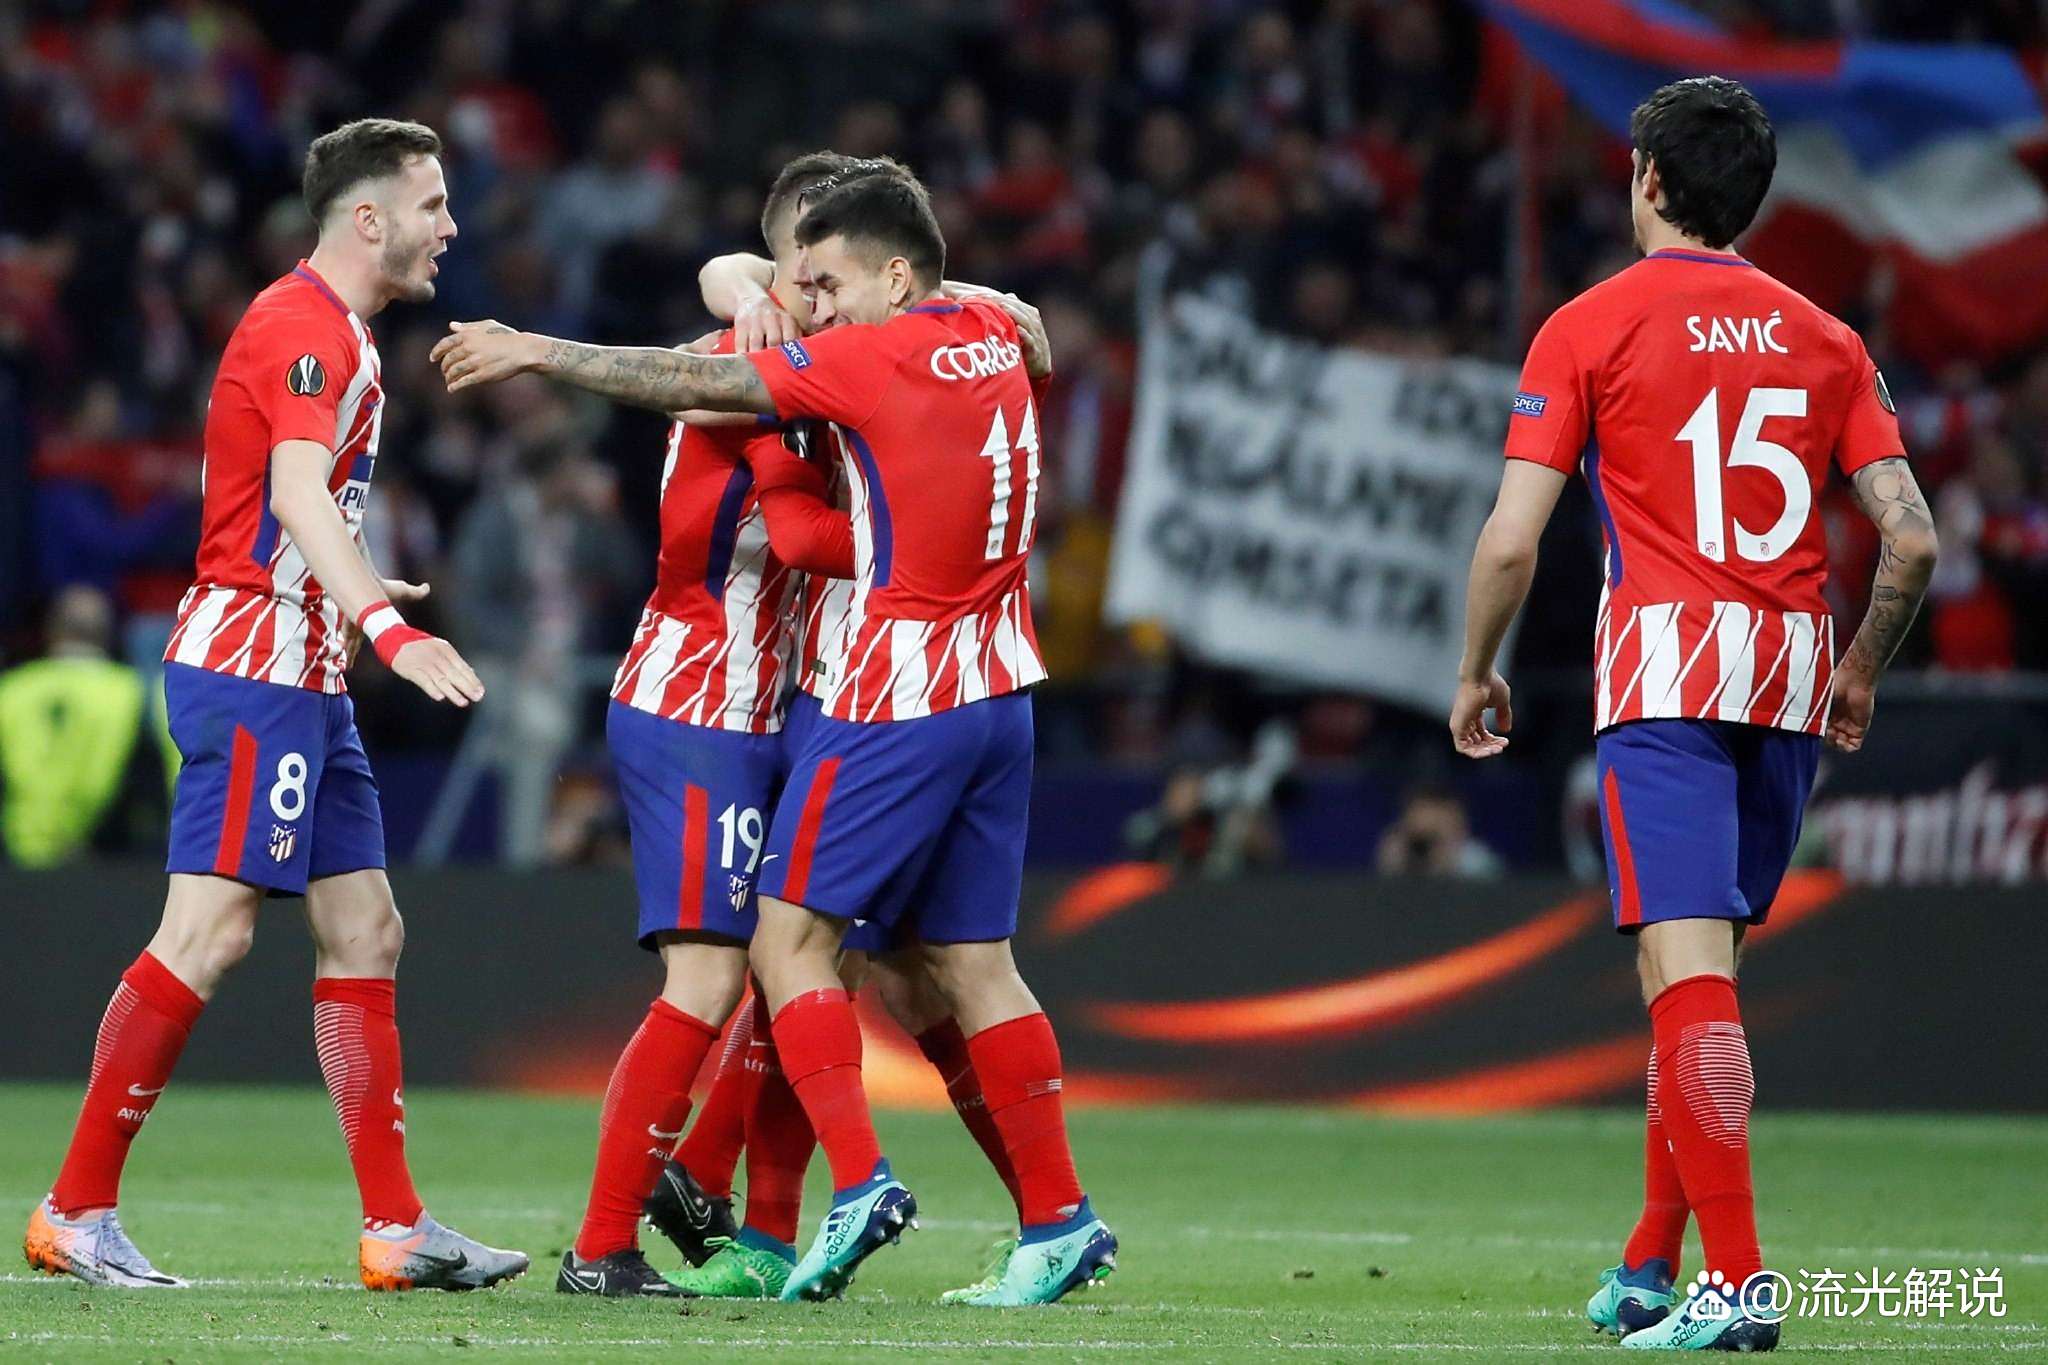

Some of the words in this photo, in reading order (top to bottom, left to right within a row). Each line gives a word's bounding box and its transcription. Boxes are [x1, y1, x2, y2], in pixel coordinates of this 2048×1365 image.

[1686, 309, 1789, 354] SAVIĆ
[979, 396, 1041, 561] 11
[1673, 386, 1812, 563] 15
[269, 751, 308, 822] 8
[717, 802, 764, 874] 19
[827, 1206, 861, 1257] adidas
